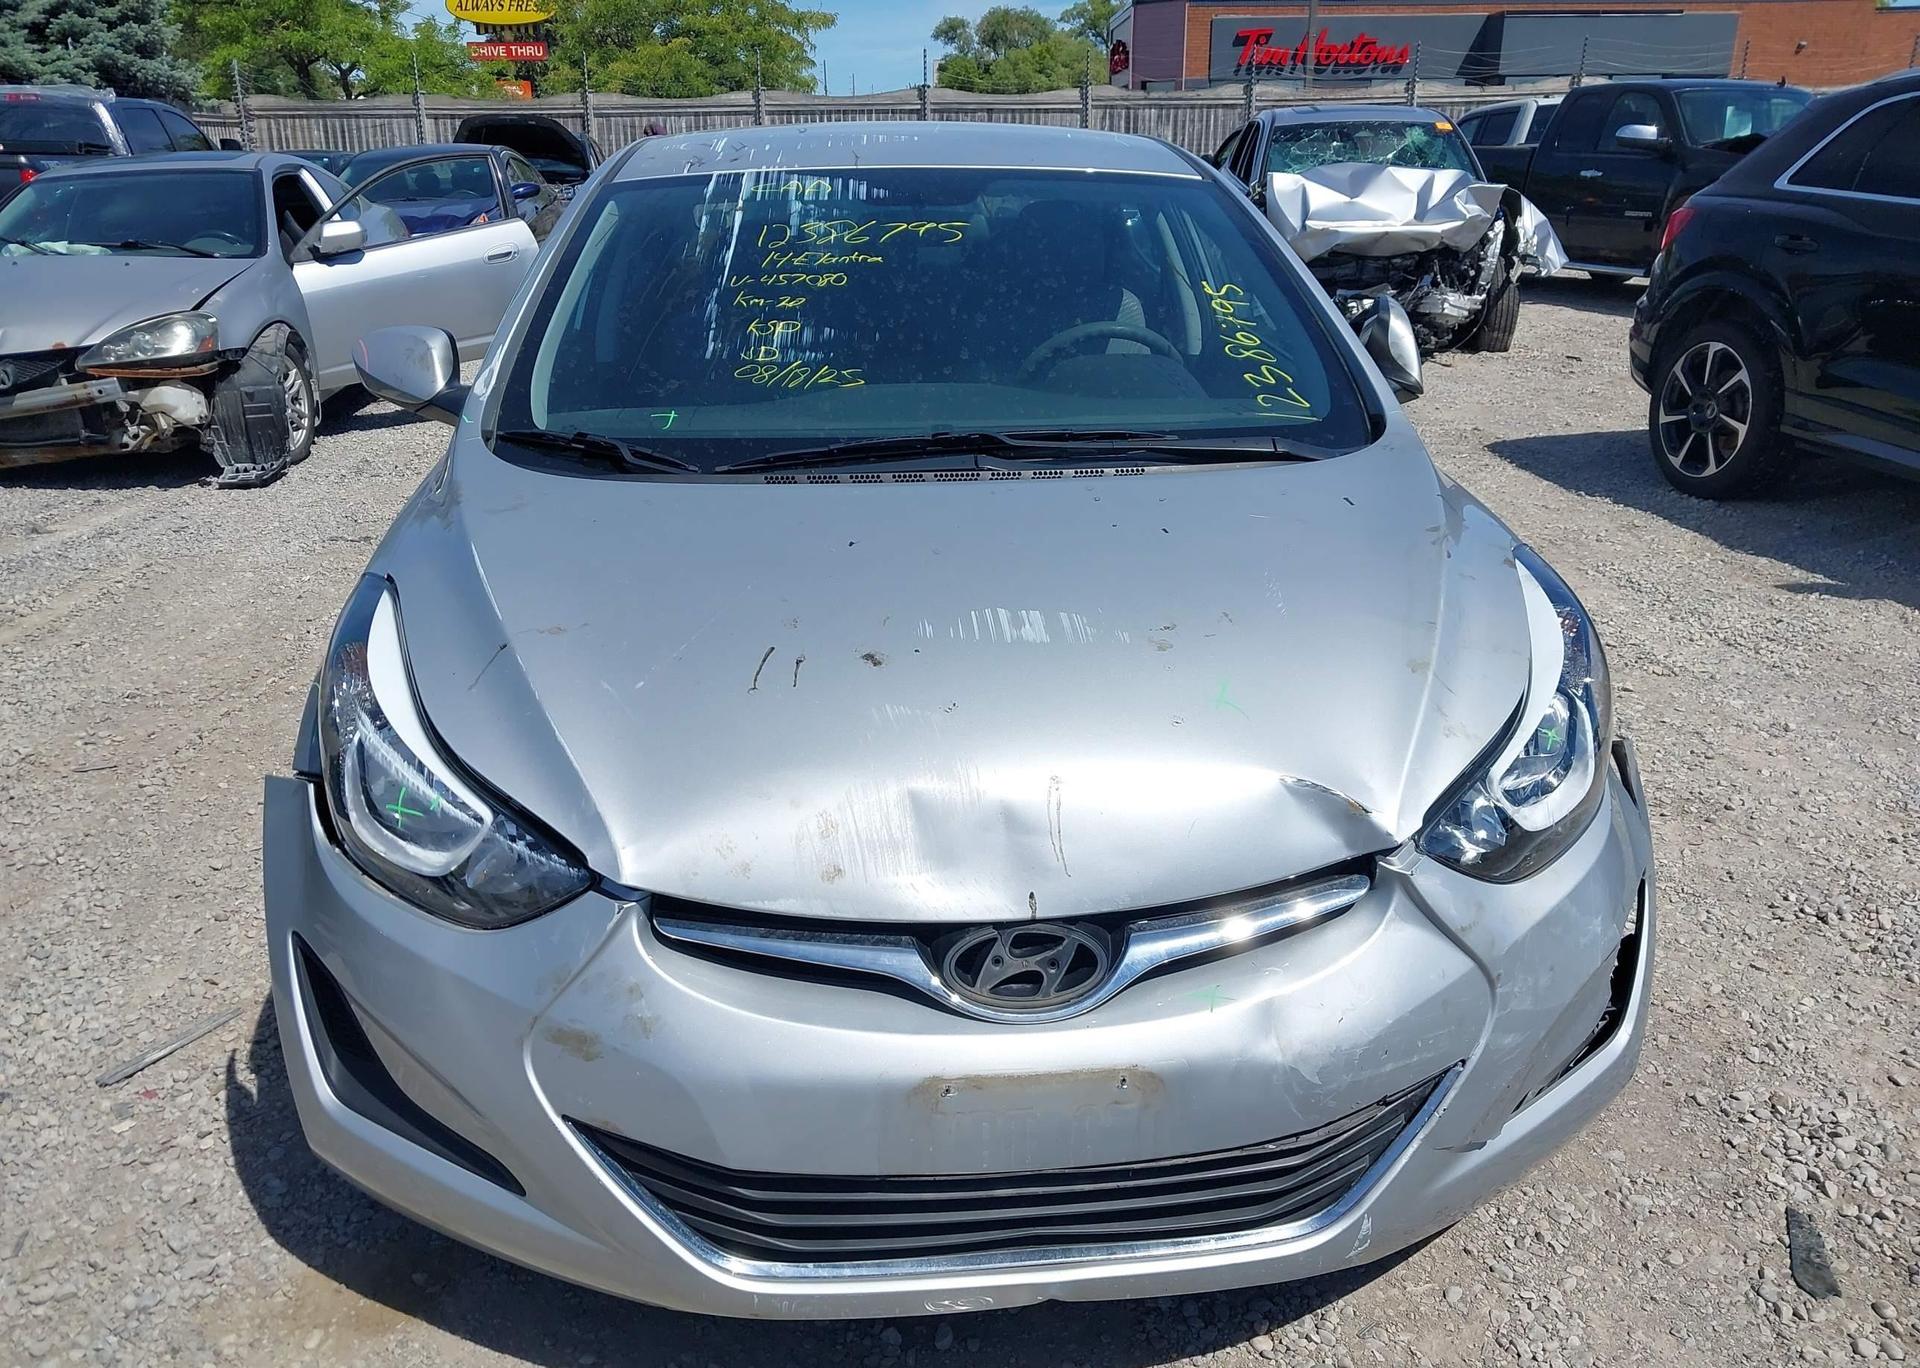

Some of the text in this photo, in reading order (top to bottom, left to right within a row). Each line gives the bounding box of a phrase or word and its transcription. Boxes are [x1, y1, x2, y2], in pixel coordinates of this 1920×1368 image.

[455, 0, 504, 12] ALWAYS
[471, 45, 543, 57] DRIVE THRU
[1236, 28, 1290, 66] Tim
